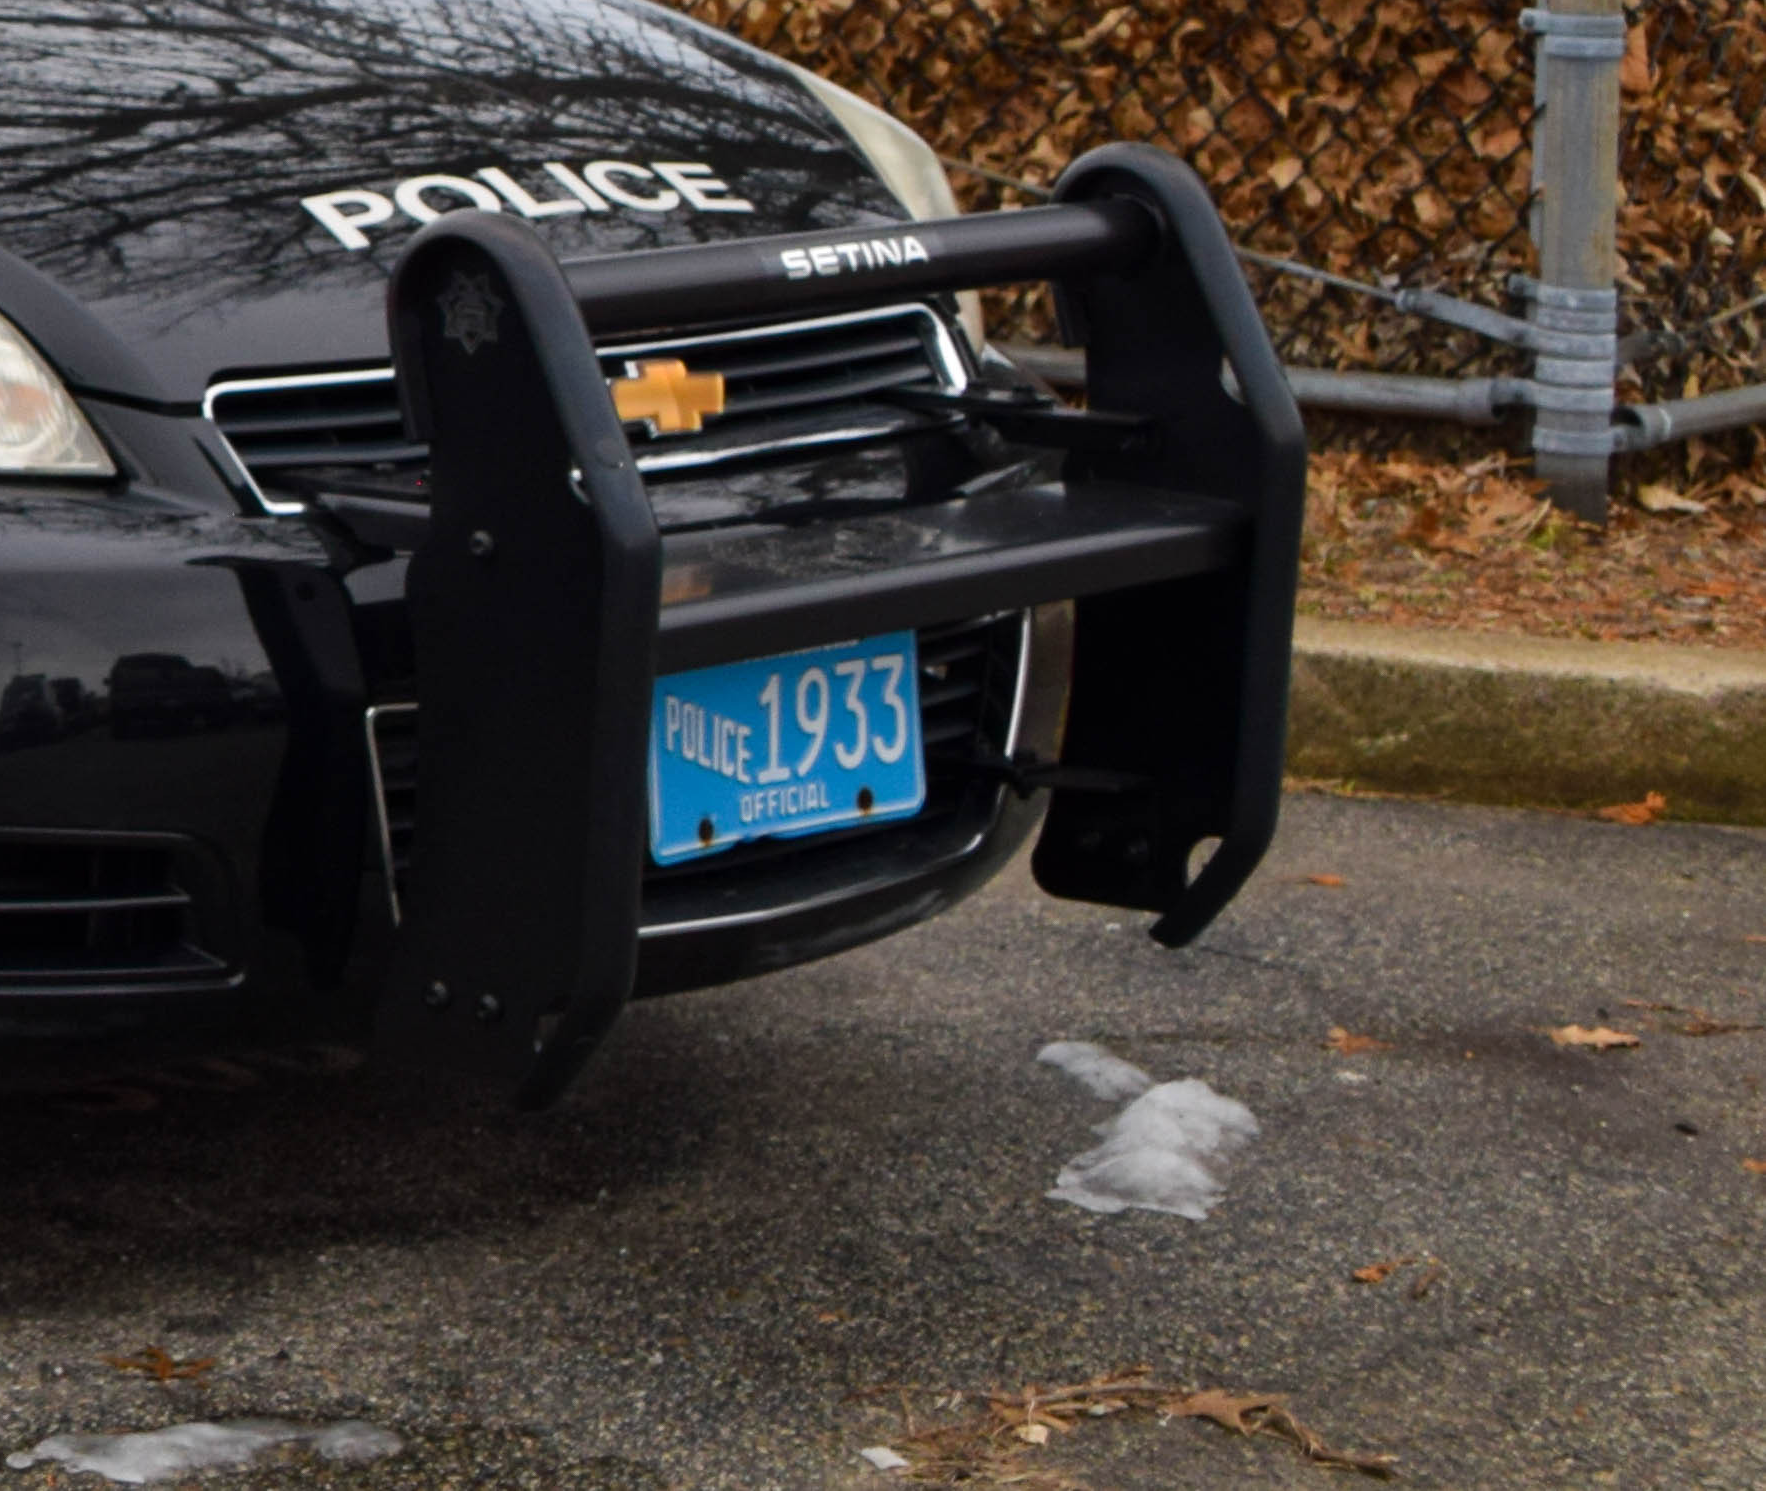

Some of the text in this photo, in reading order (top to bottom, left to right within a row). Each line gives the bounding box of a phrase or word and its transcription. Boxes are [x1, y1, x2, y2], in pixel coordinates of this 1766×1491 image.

[301, 160, 754, 251] POLICE
[781, 234, 931, 279] SETINA
[664, 653, 908, 786] POLICE 1933
[738, 781, 832, 824] OFFICIAL
